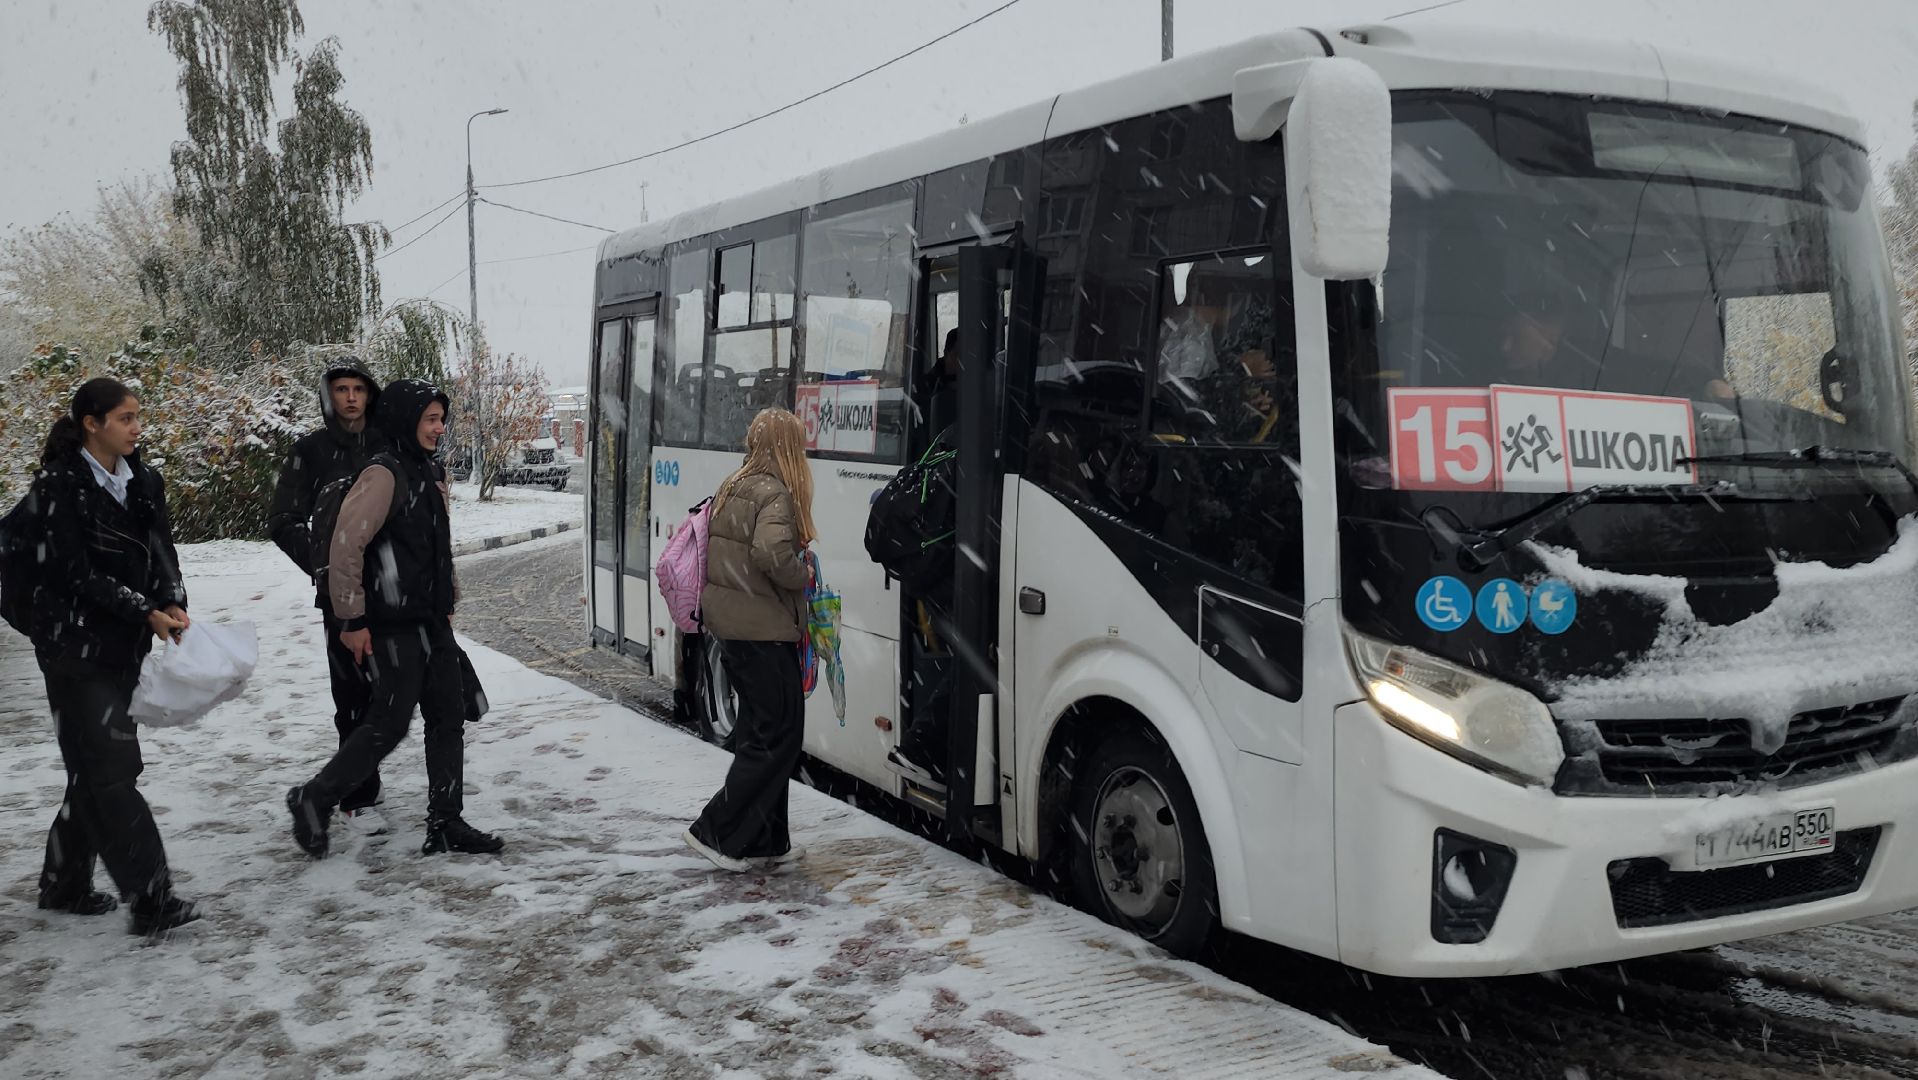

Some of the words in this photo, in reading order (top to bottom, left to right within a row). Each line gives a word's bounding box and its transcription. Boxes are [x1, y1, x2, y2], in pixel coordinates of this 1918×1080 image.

[836, 404, 874, 431] ШКОЛА
[1400, 405, 1493, 484] 15
[1568, 429, 1691, 474] ШКОЛА
[1797, 812, 1828, 837] 550
